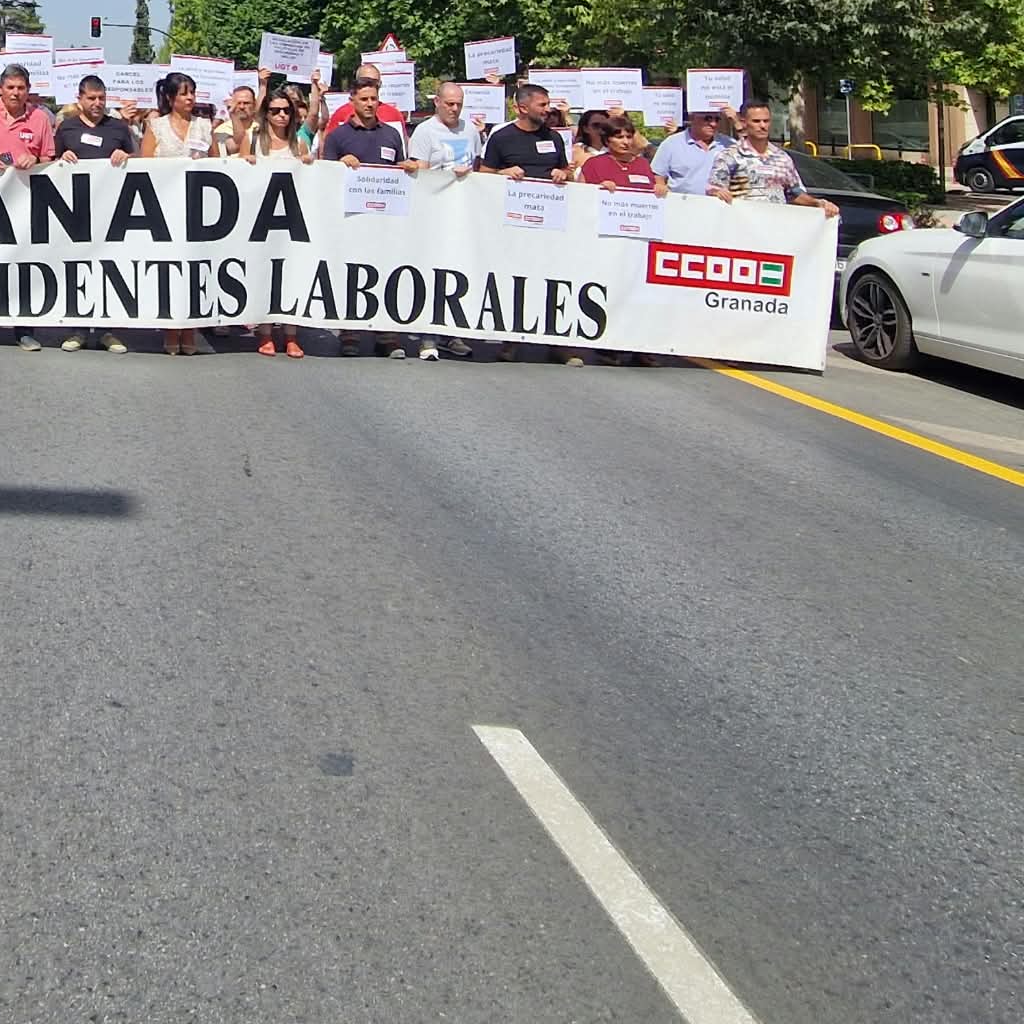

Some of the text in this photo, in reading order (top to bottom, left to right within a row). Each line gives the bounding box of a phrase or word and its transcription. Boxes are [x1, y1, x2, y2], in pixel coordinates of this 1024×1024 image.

[275, 63, 291, 71] UGT
[357, 175, 399, 185] Solidaridad
[376, 187, 406, 196] familias
[508, 190, 565, 202] La precariedad
[523, 203, 545, 212] mata
[601, 199, 612, 207] No
[630, 202, 659, 210] muertes
[269, 259, 607, 340] LABORALES
[705, 291, 789, 315] Granada
